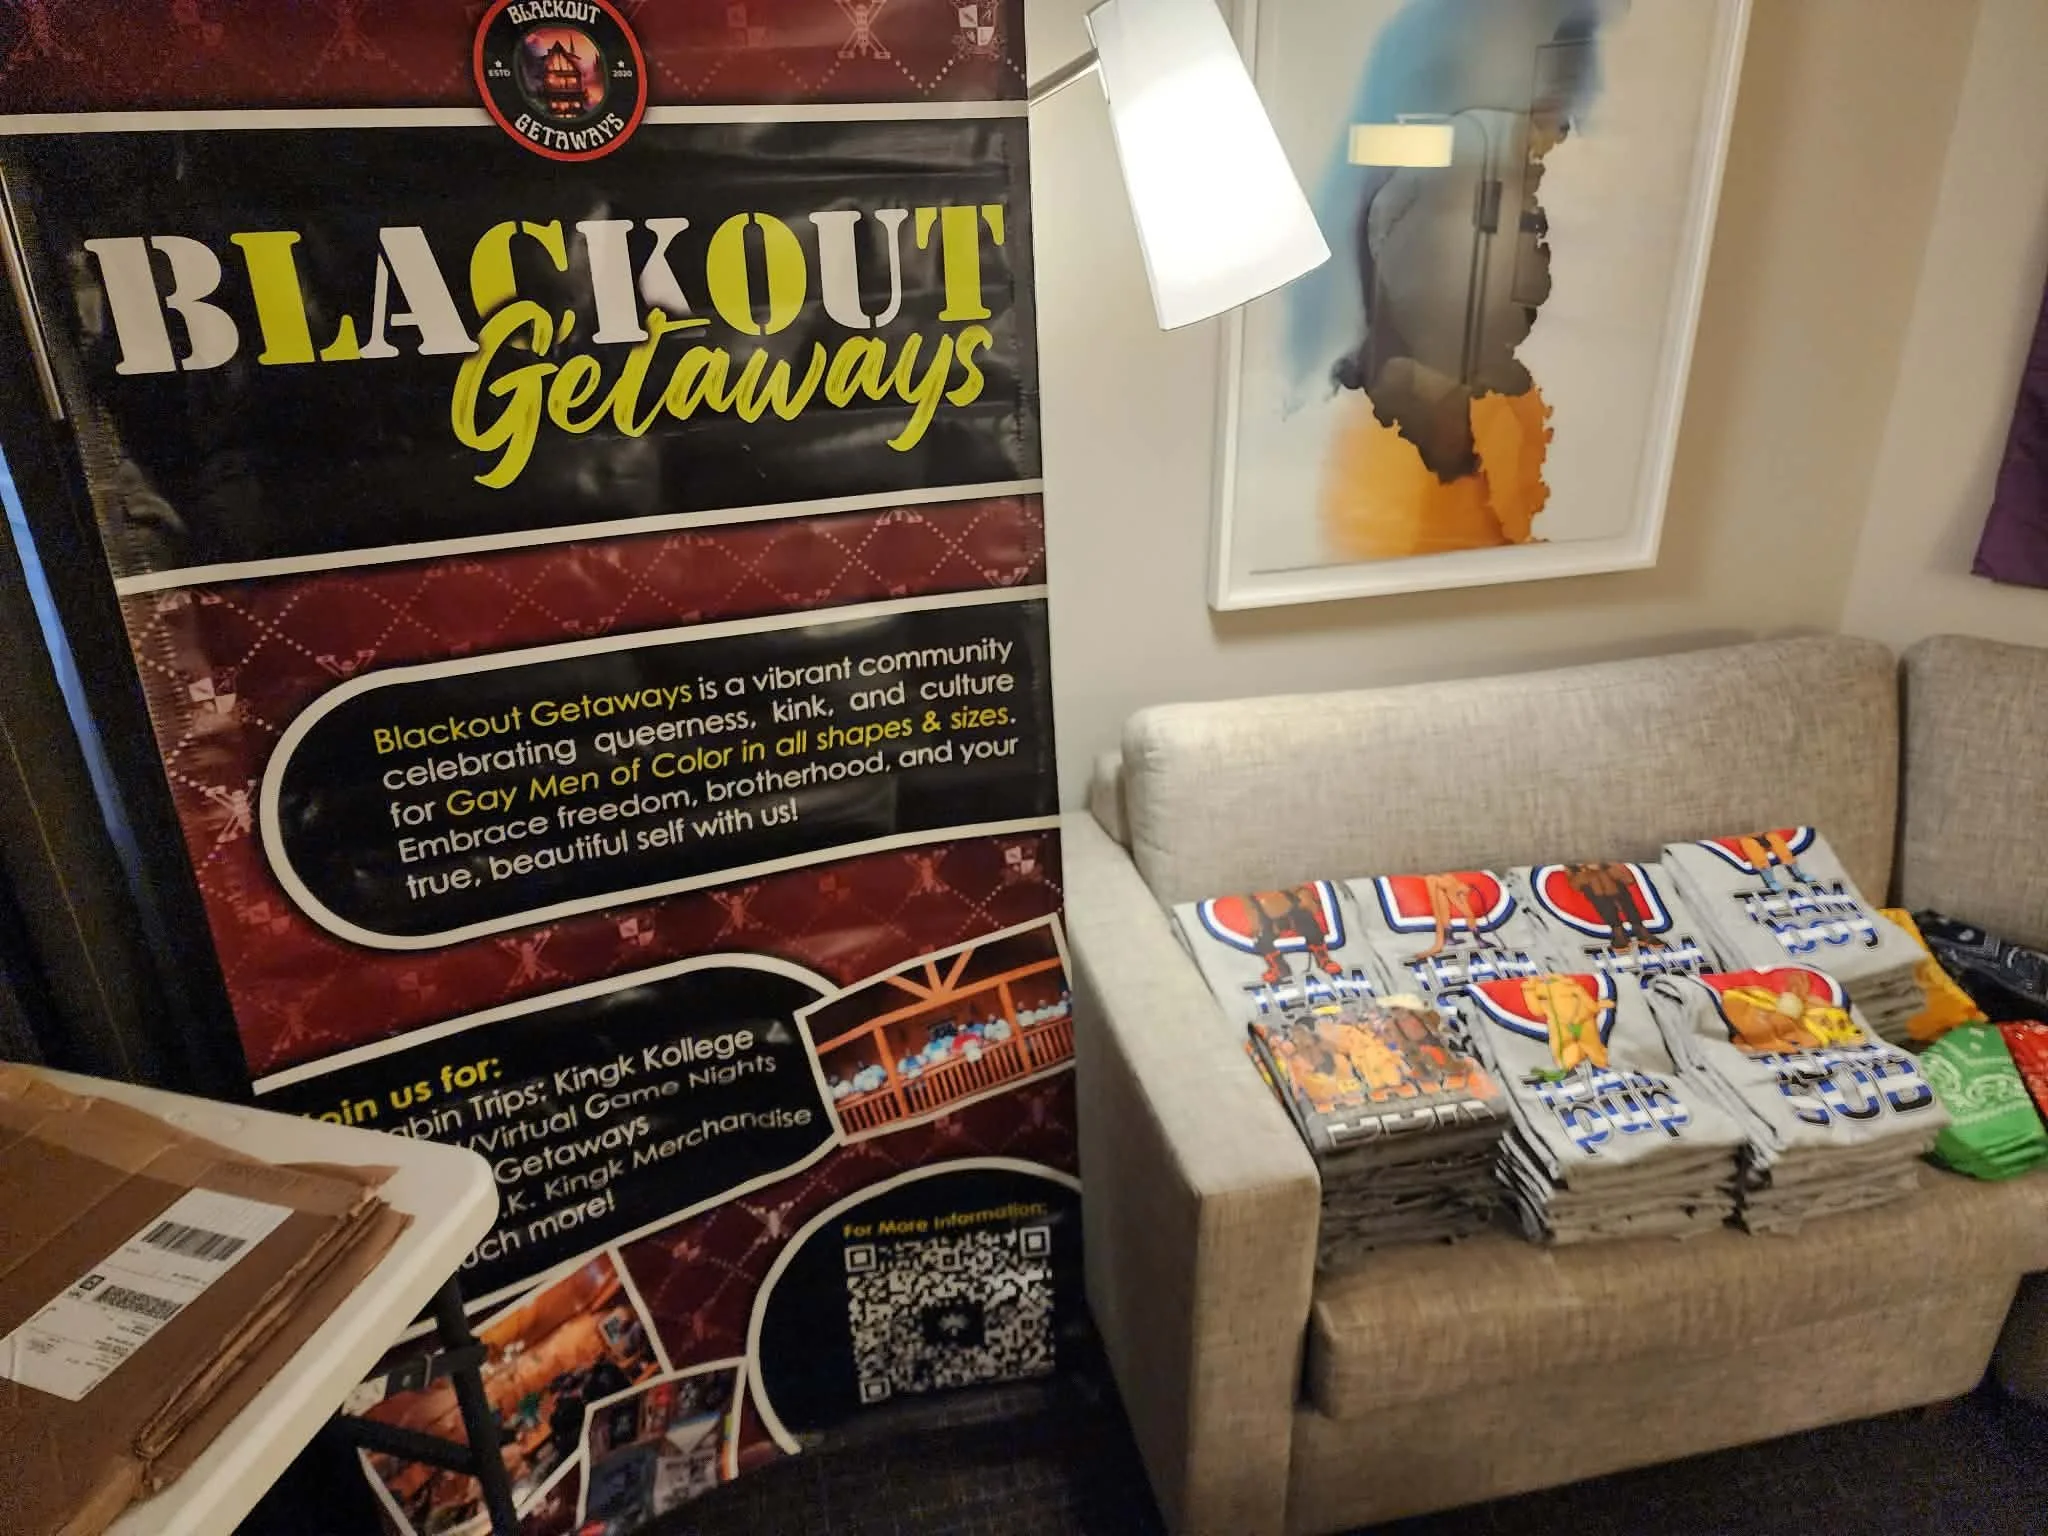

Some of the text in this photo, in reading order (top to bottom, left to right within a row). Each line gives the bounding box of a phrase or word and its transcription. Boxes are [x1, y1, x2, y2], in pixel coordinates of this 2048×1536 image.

[507, 0, 601, 24] BLACKOUT
[514, 112, 625, 150] GETAWAYS
[85, 204, 1005, 376] BLACKOUT
[450, 301, 996, 489] Getaways
[373, 636, 1013, 755] Blackout Getaways is a vibrant community
[383, 670, 1014, 791] celebrating queerness, kink, and culture
[391, 704, 1016, 829] for Gay Men of Color in all shapes & sizes.
[398, 736, 1019, 863] Embrace freedom, brotherhood, and your
[406, 800, 798, 900] true, beautiful self with us!
[1733, 880, 1863, 923] TEAM
[303, 1058, 502, 1127] oin us for:
[368, 1027, 755, 1140] abin Trips: Kingk Kollege
[585, 1081, 679, 1120] Game
[689, 1055, 777, 1091] Nights
[493, 1116, 650, 1184] Getaways
[545, 1160, 623, 1200] Kingk
[632, 1105, 812, 1168] Merchandise
[463, 1189, 616, 1269] uch more!
[843, 1223, 873, 1238] For
[879, 1219, 928, 1234] More
